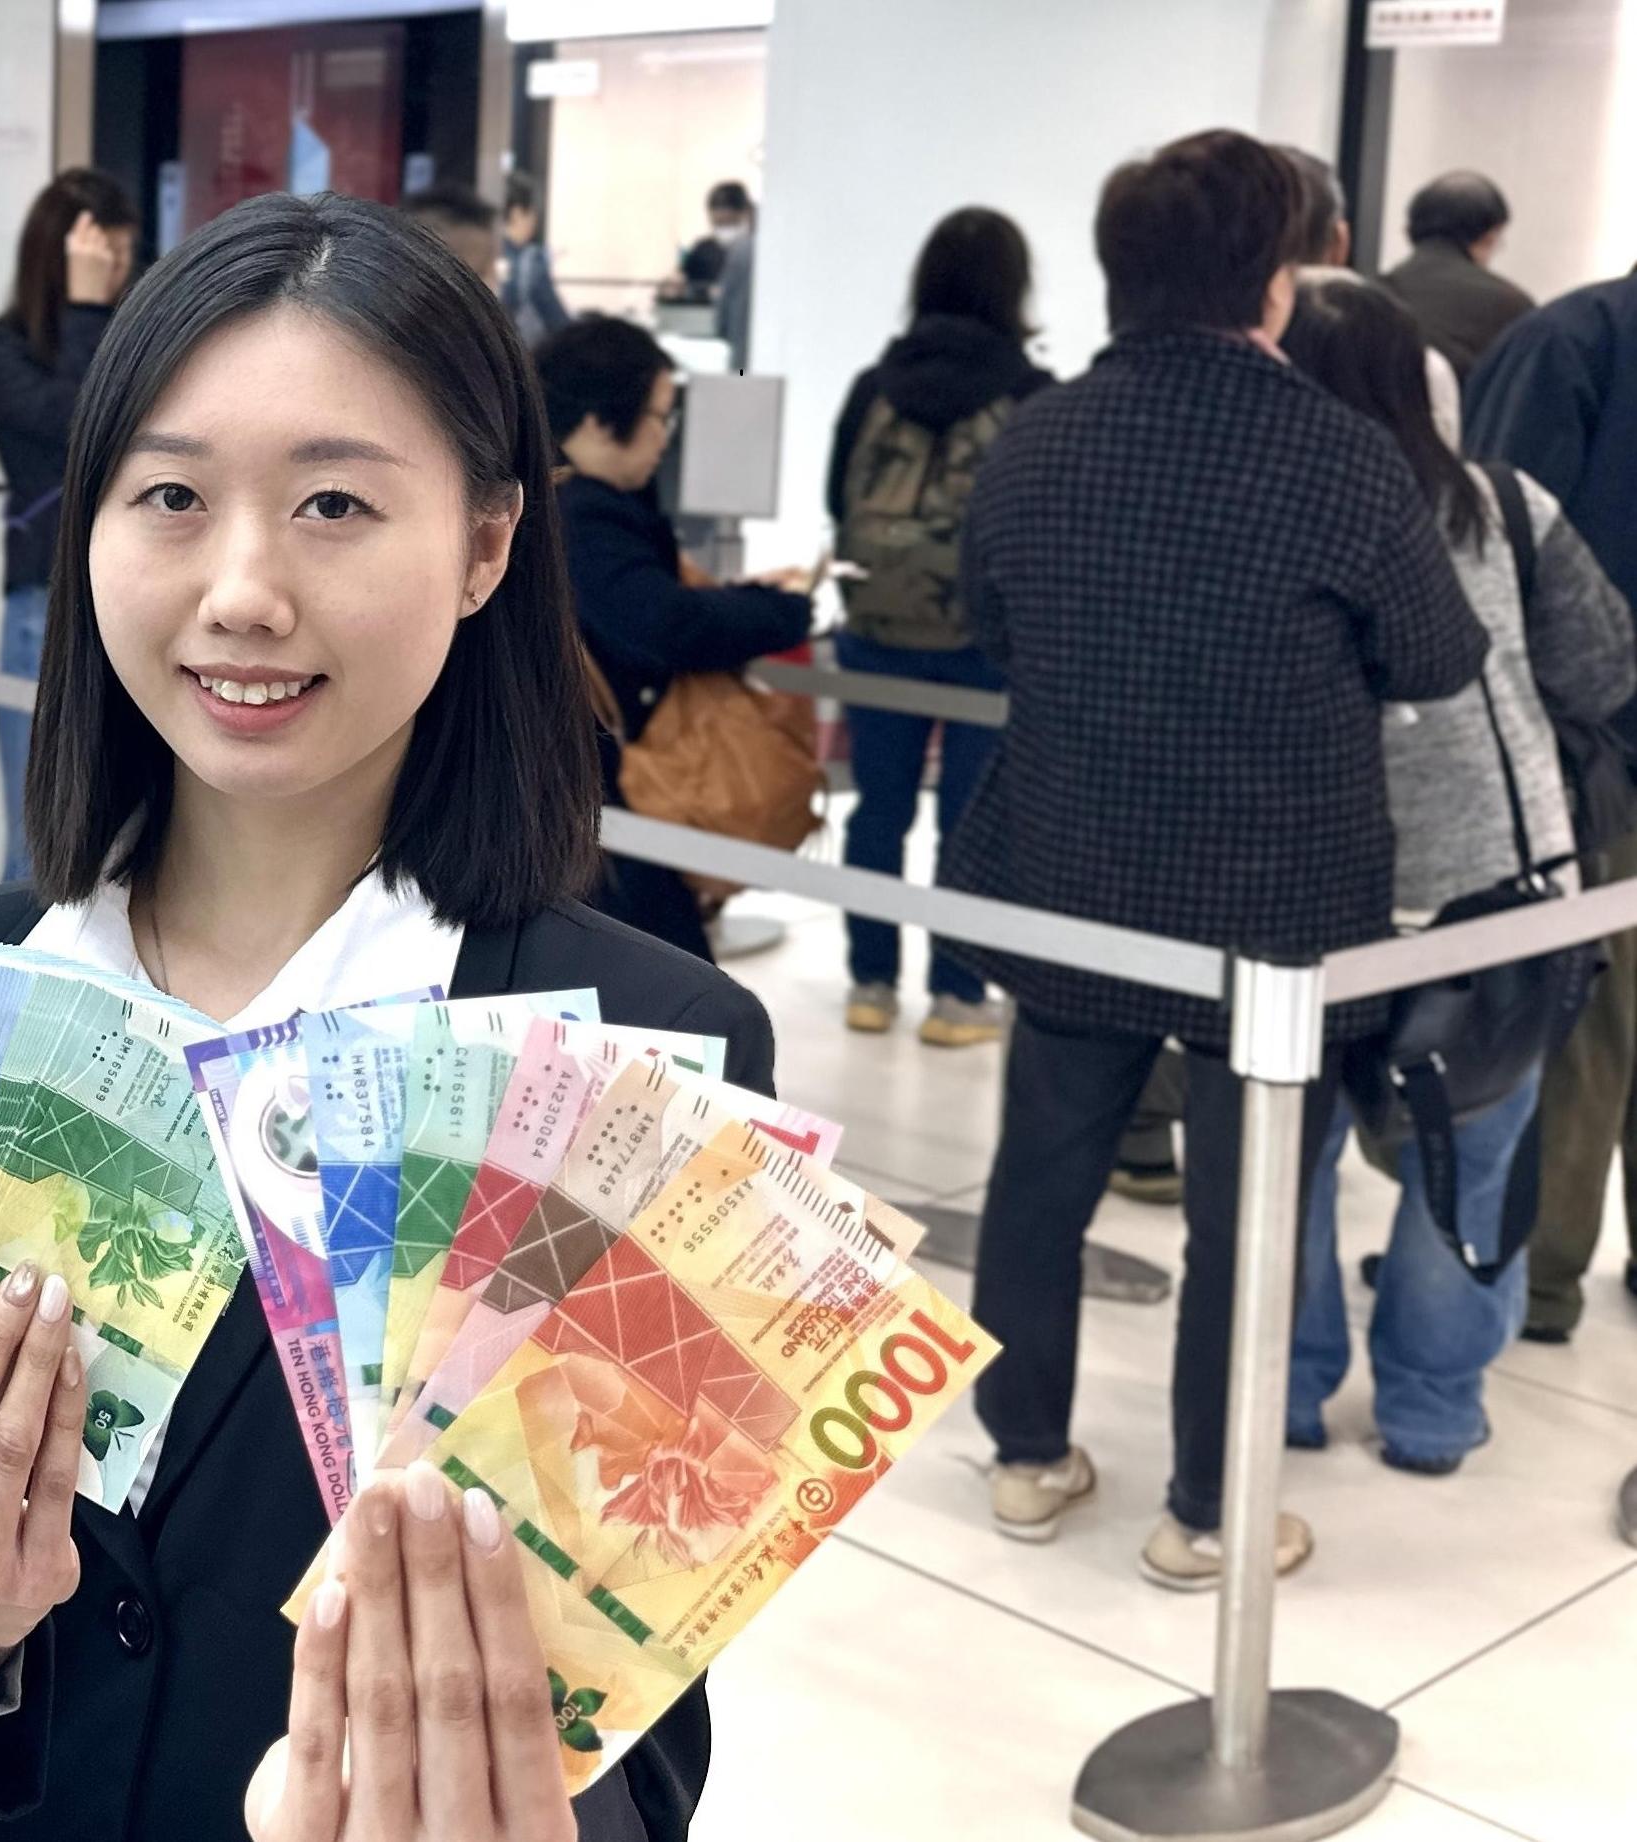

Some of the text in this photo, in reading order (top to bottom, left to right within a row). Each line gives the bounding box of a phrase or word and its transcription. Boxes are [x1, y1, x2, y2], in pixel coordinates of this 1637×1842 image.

[92, 1035, 136, 1103] BM165689
[350, 1054, 375, 1147] HW837584
[447, 1046, 468, 1138] CA165611
[529, 1069, 573, 1160] AA230064
[596, 1111, 655, 1197] AM877448
[681, 1177, 754, 1254] AA506556
[782, 1257, 858, 1337] HONG KONG DOLLARS
[837, 1263, 870, 1297] ONE
[778, 1290, 844, 1360] THOUSAND
[95, 1410, 111, 1429] 50
[286, 1338, 350, 1514] TEN HONG KONG DOLL
[810, 1309, 977, 1469] 1000
[555, 1702, 582, 1729] 100
